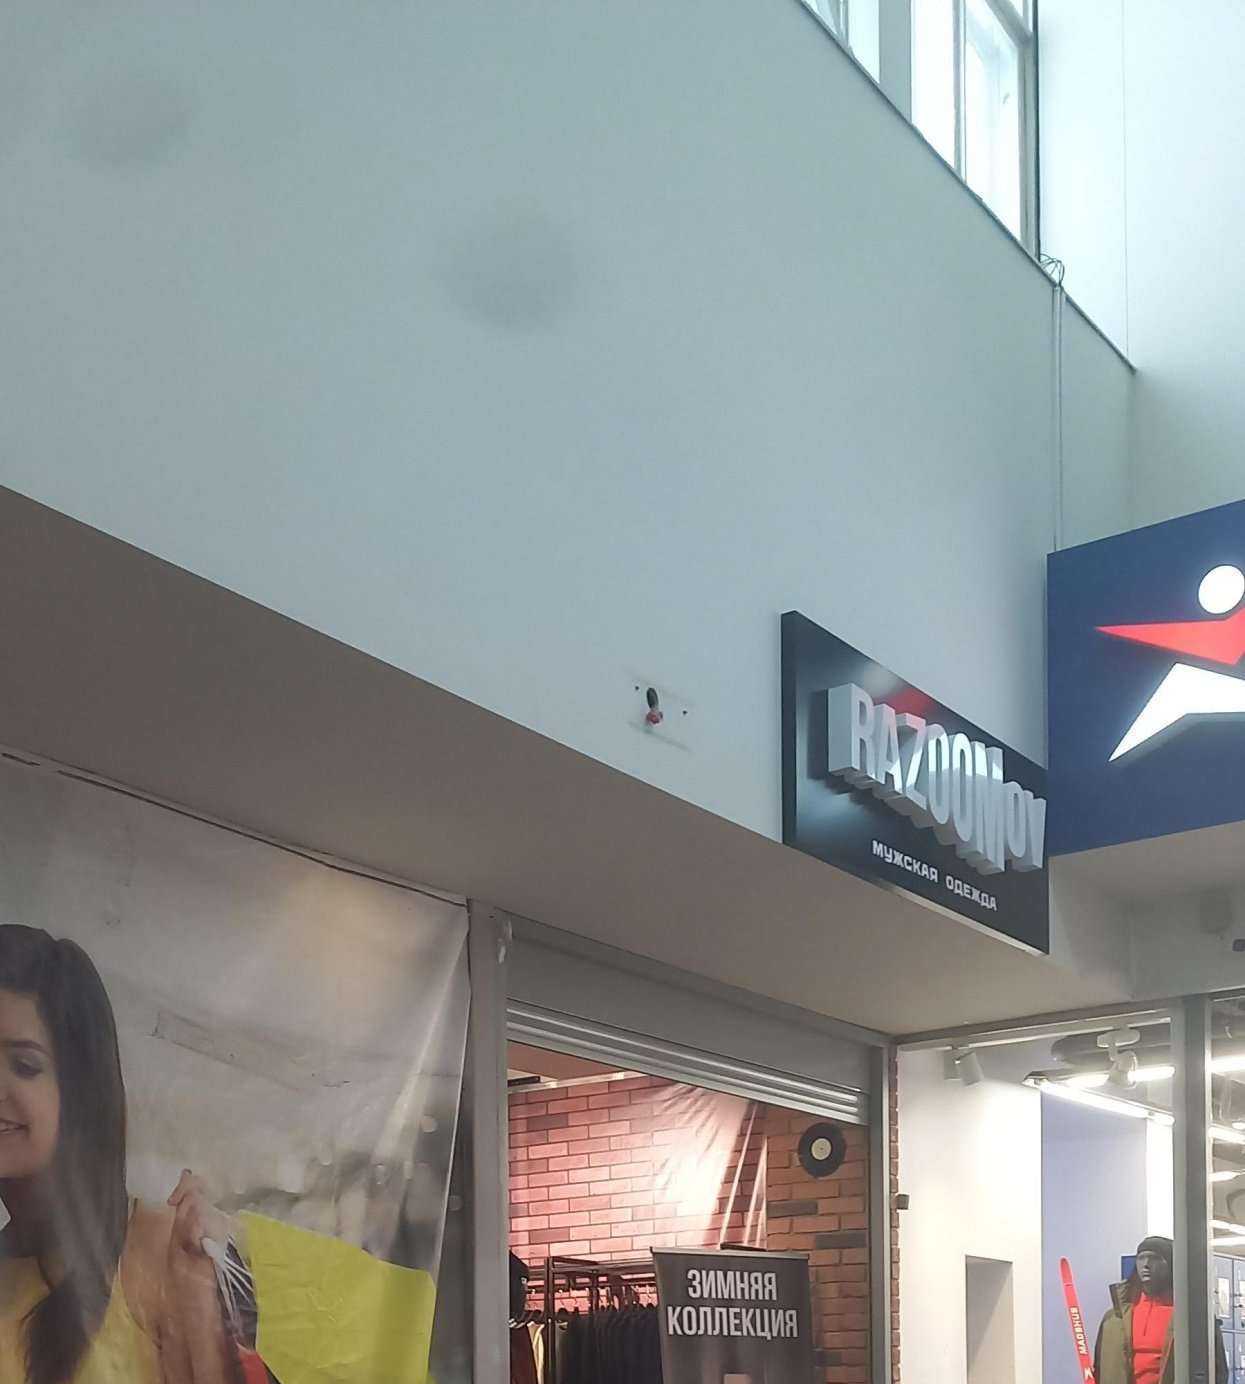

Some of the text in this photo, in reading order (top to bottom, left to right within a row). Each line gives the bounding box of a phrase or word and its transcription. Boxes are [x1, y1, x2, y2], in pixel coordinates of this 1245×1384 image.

[872, 839, 998, 911] МУЖСКАЯ ОДЕЖДА
[687, 1269, 778, 1301] ЗИМНЯЯ
[666, 1305, 799, 1341] КОЛЛЕКЦИЯ
